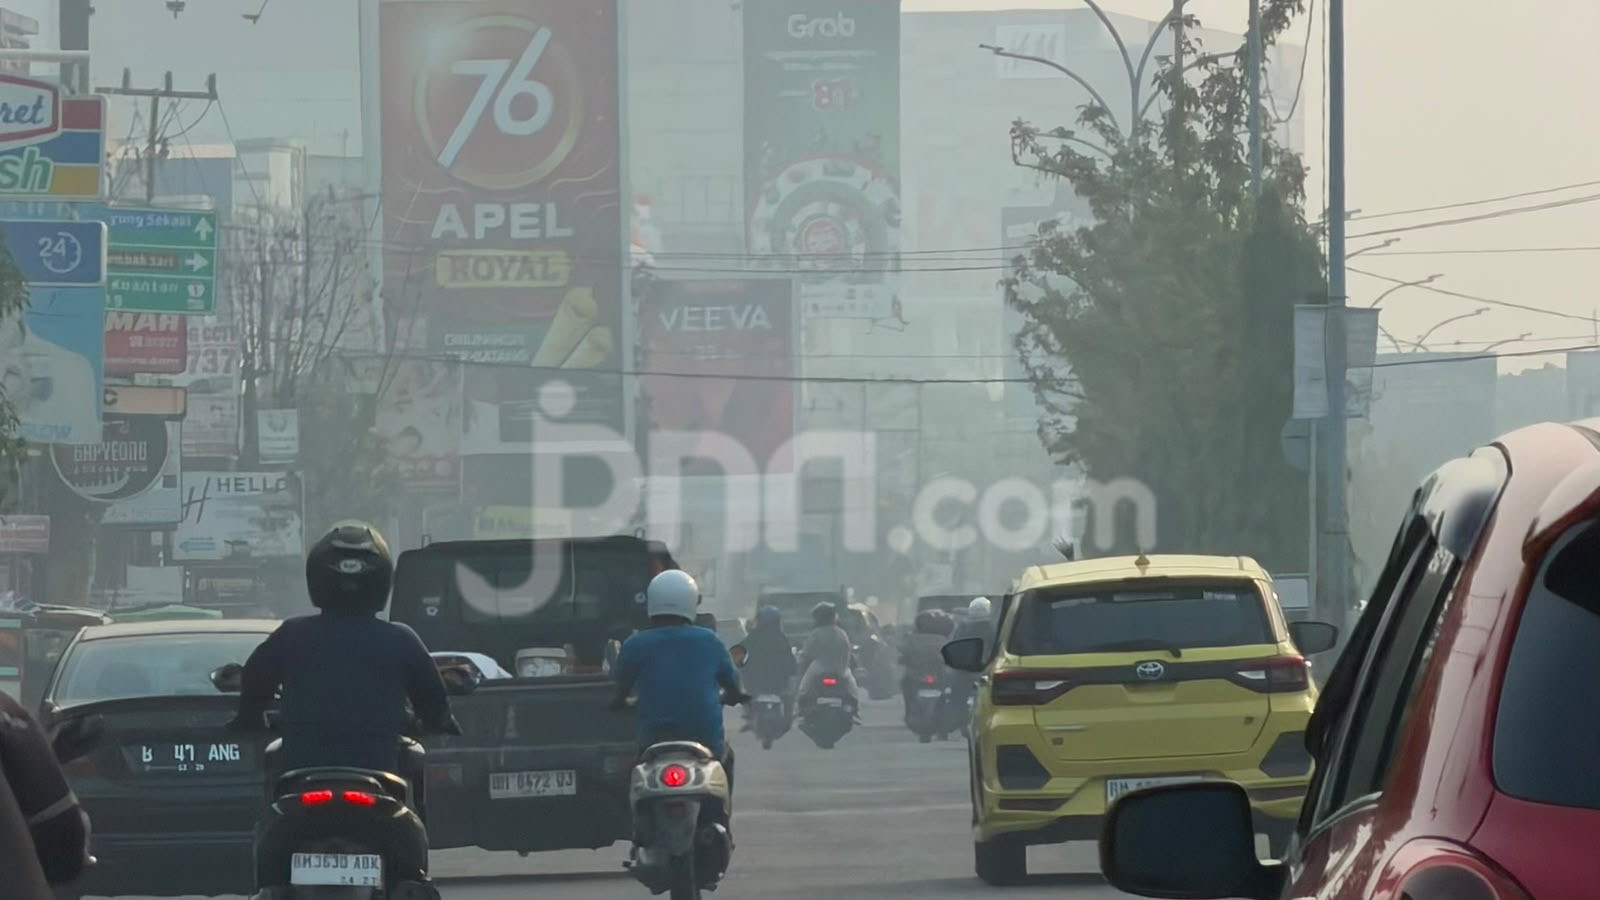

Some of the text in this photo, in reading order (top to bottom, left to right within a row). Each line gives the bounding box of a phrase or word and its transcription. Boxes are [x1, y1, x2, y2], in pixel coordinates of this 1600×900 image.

[787, 12, 855, 38] Grab
[436, 26, 553, 170] 76
[431, 203, 574, 240] APEL
[38, 236, 66, 258] 24
[450, 254, 560, 281] ROYAL
[659, 304, 772, 331] VEEVA
[208, 743, 241, 761] ANG
